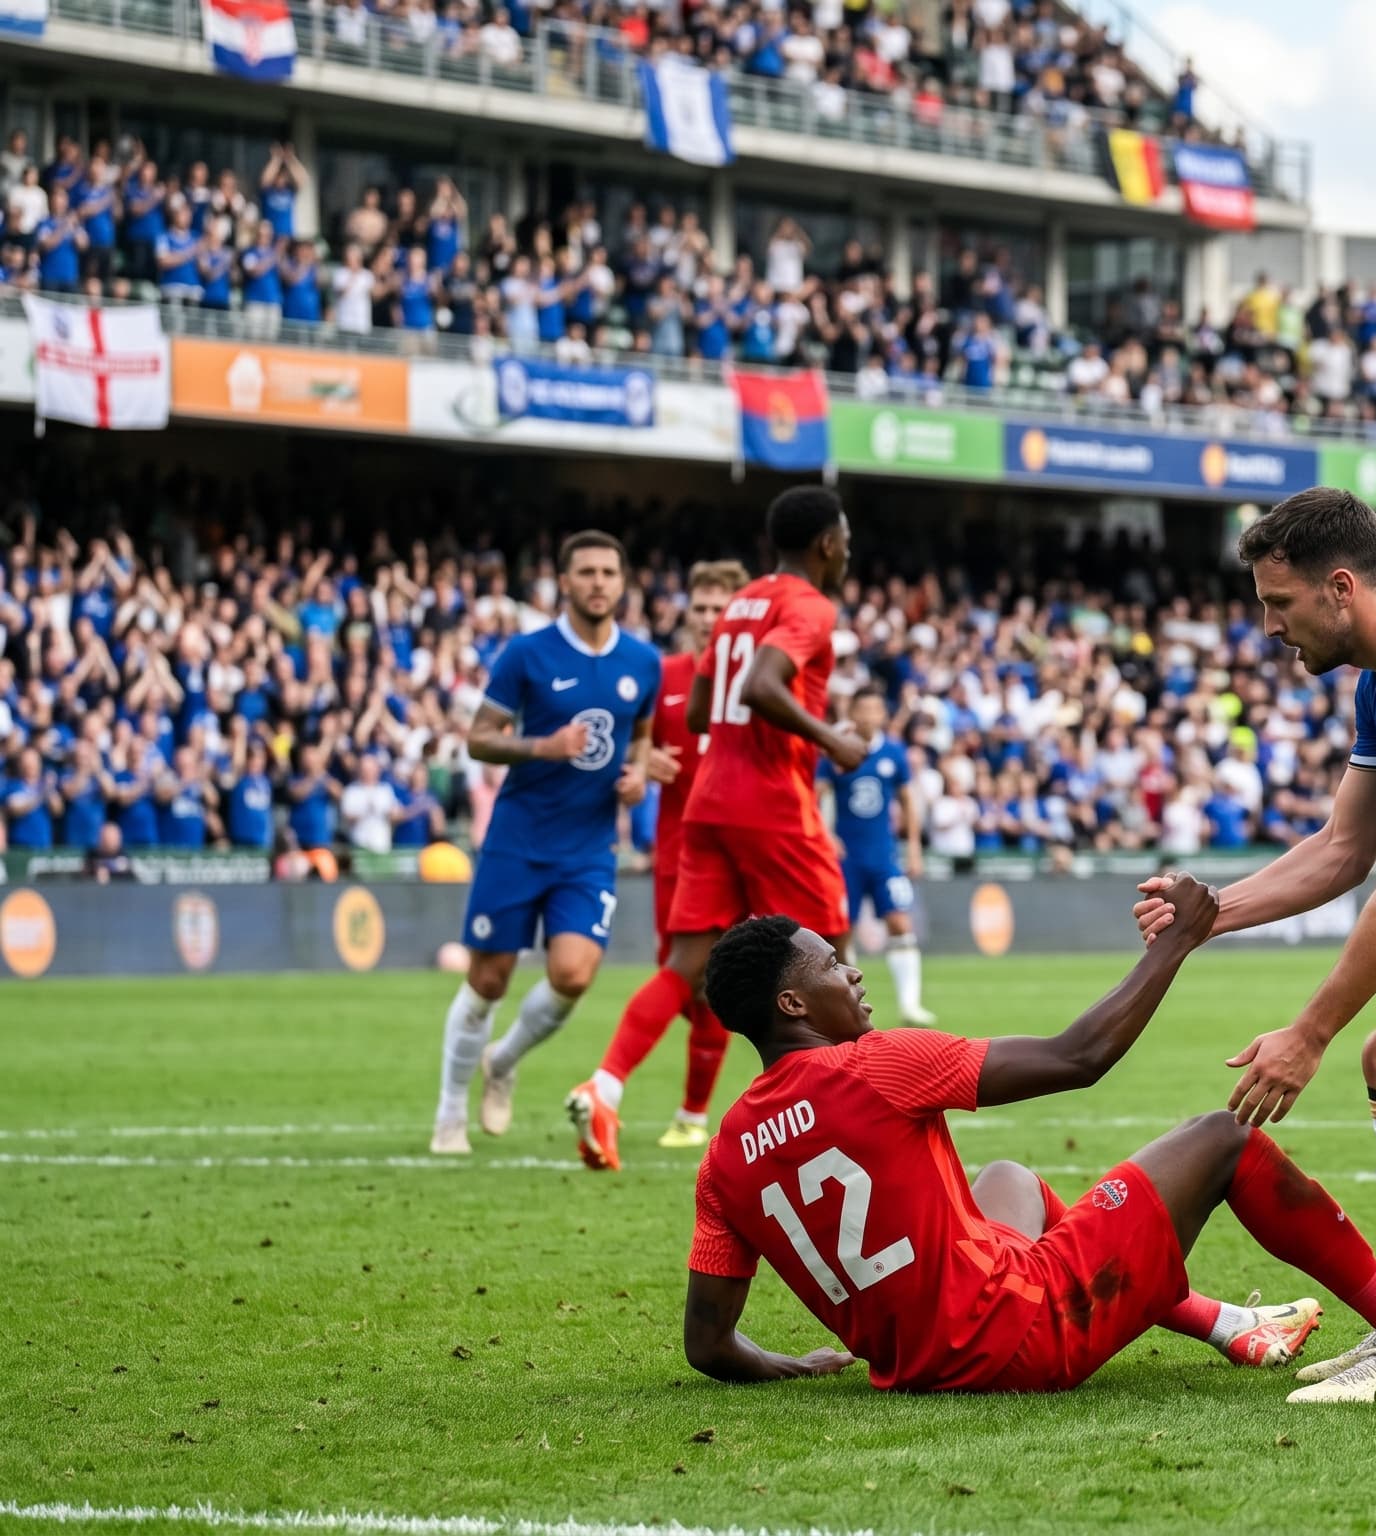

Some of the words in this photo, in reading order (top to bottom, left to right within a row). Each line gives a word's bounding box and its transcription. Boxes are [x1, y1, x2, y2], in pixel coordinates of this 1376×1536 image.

[710, 632, 754, 725] 12
[740, 1099, 816, 1165] DAVID
[761, 1146, 915, 1306] 12
